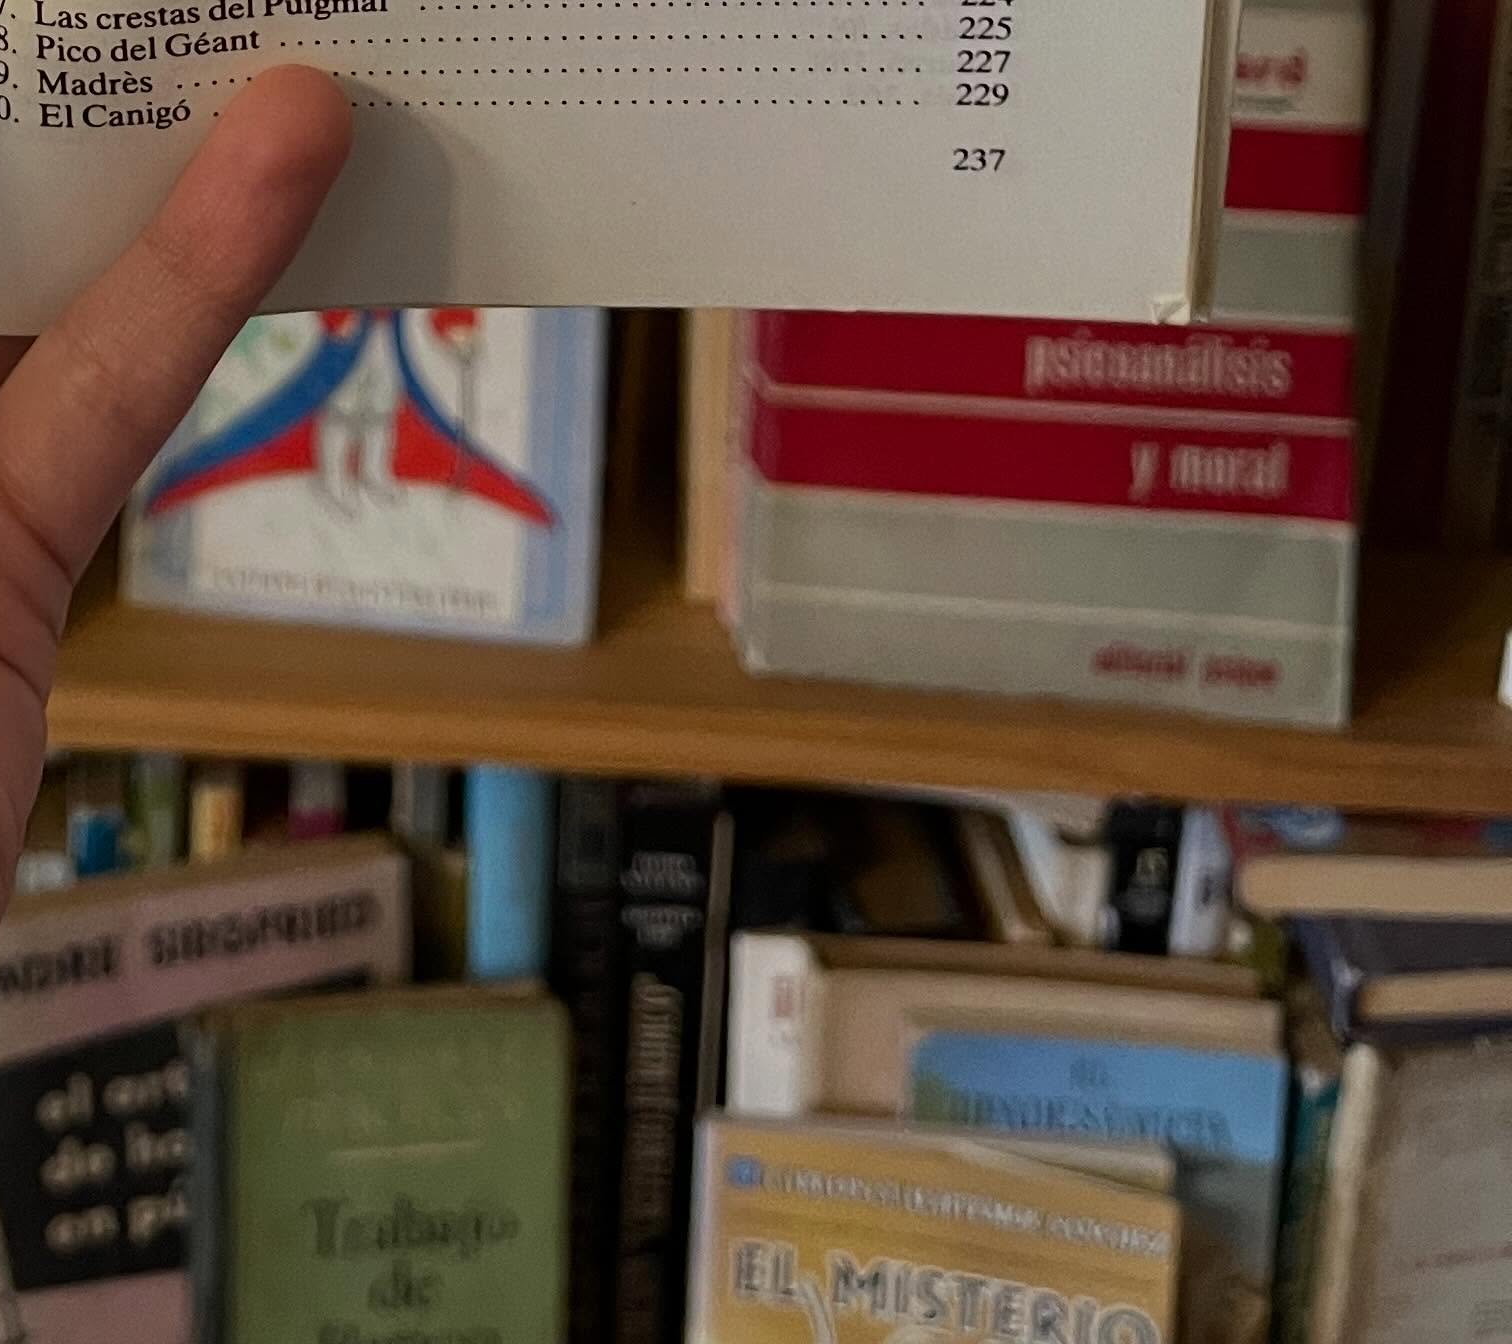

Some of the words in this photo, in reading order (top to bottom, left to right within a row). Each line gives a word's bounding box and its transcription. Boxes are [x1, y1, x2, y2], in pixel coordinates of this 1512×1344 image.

[33, 0, 89, 30] Las
[95, 6, 201, 31] crestas
[37, 102, 75, 129] El
[81, 98, 192, 130] Canigó
[955, 82, 1010, 107] 229
[952, 147, 1006, 172] 237
[1129, 442, 1161, 502] y
[732, 1241, 799, 1298] EL
[826, 1250, 1164, 1344] MISTERIO
